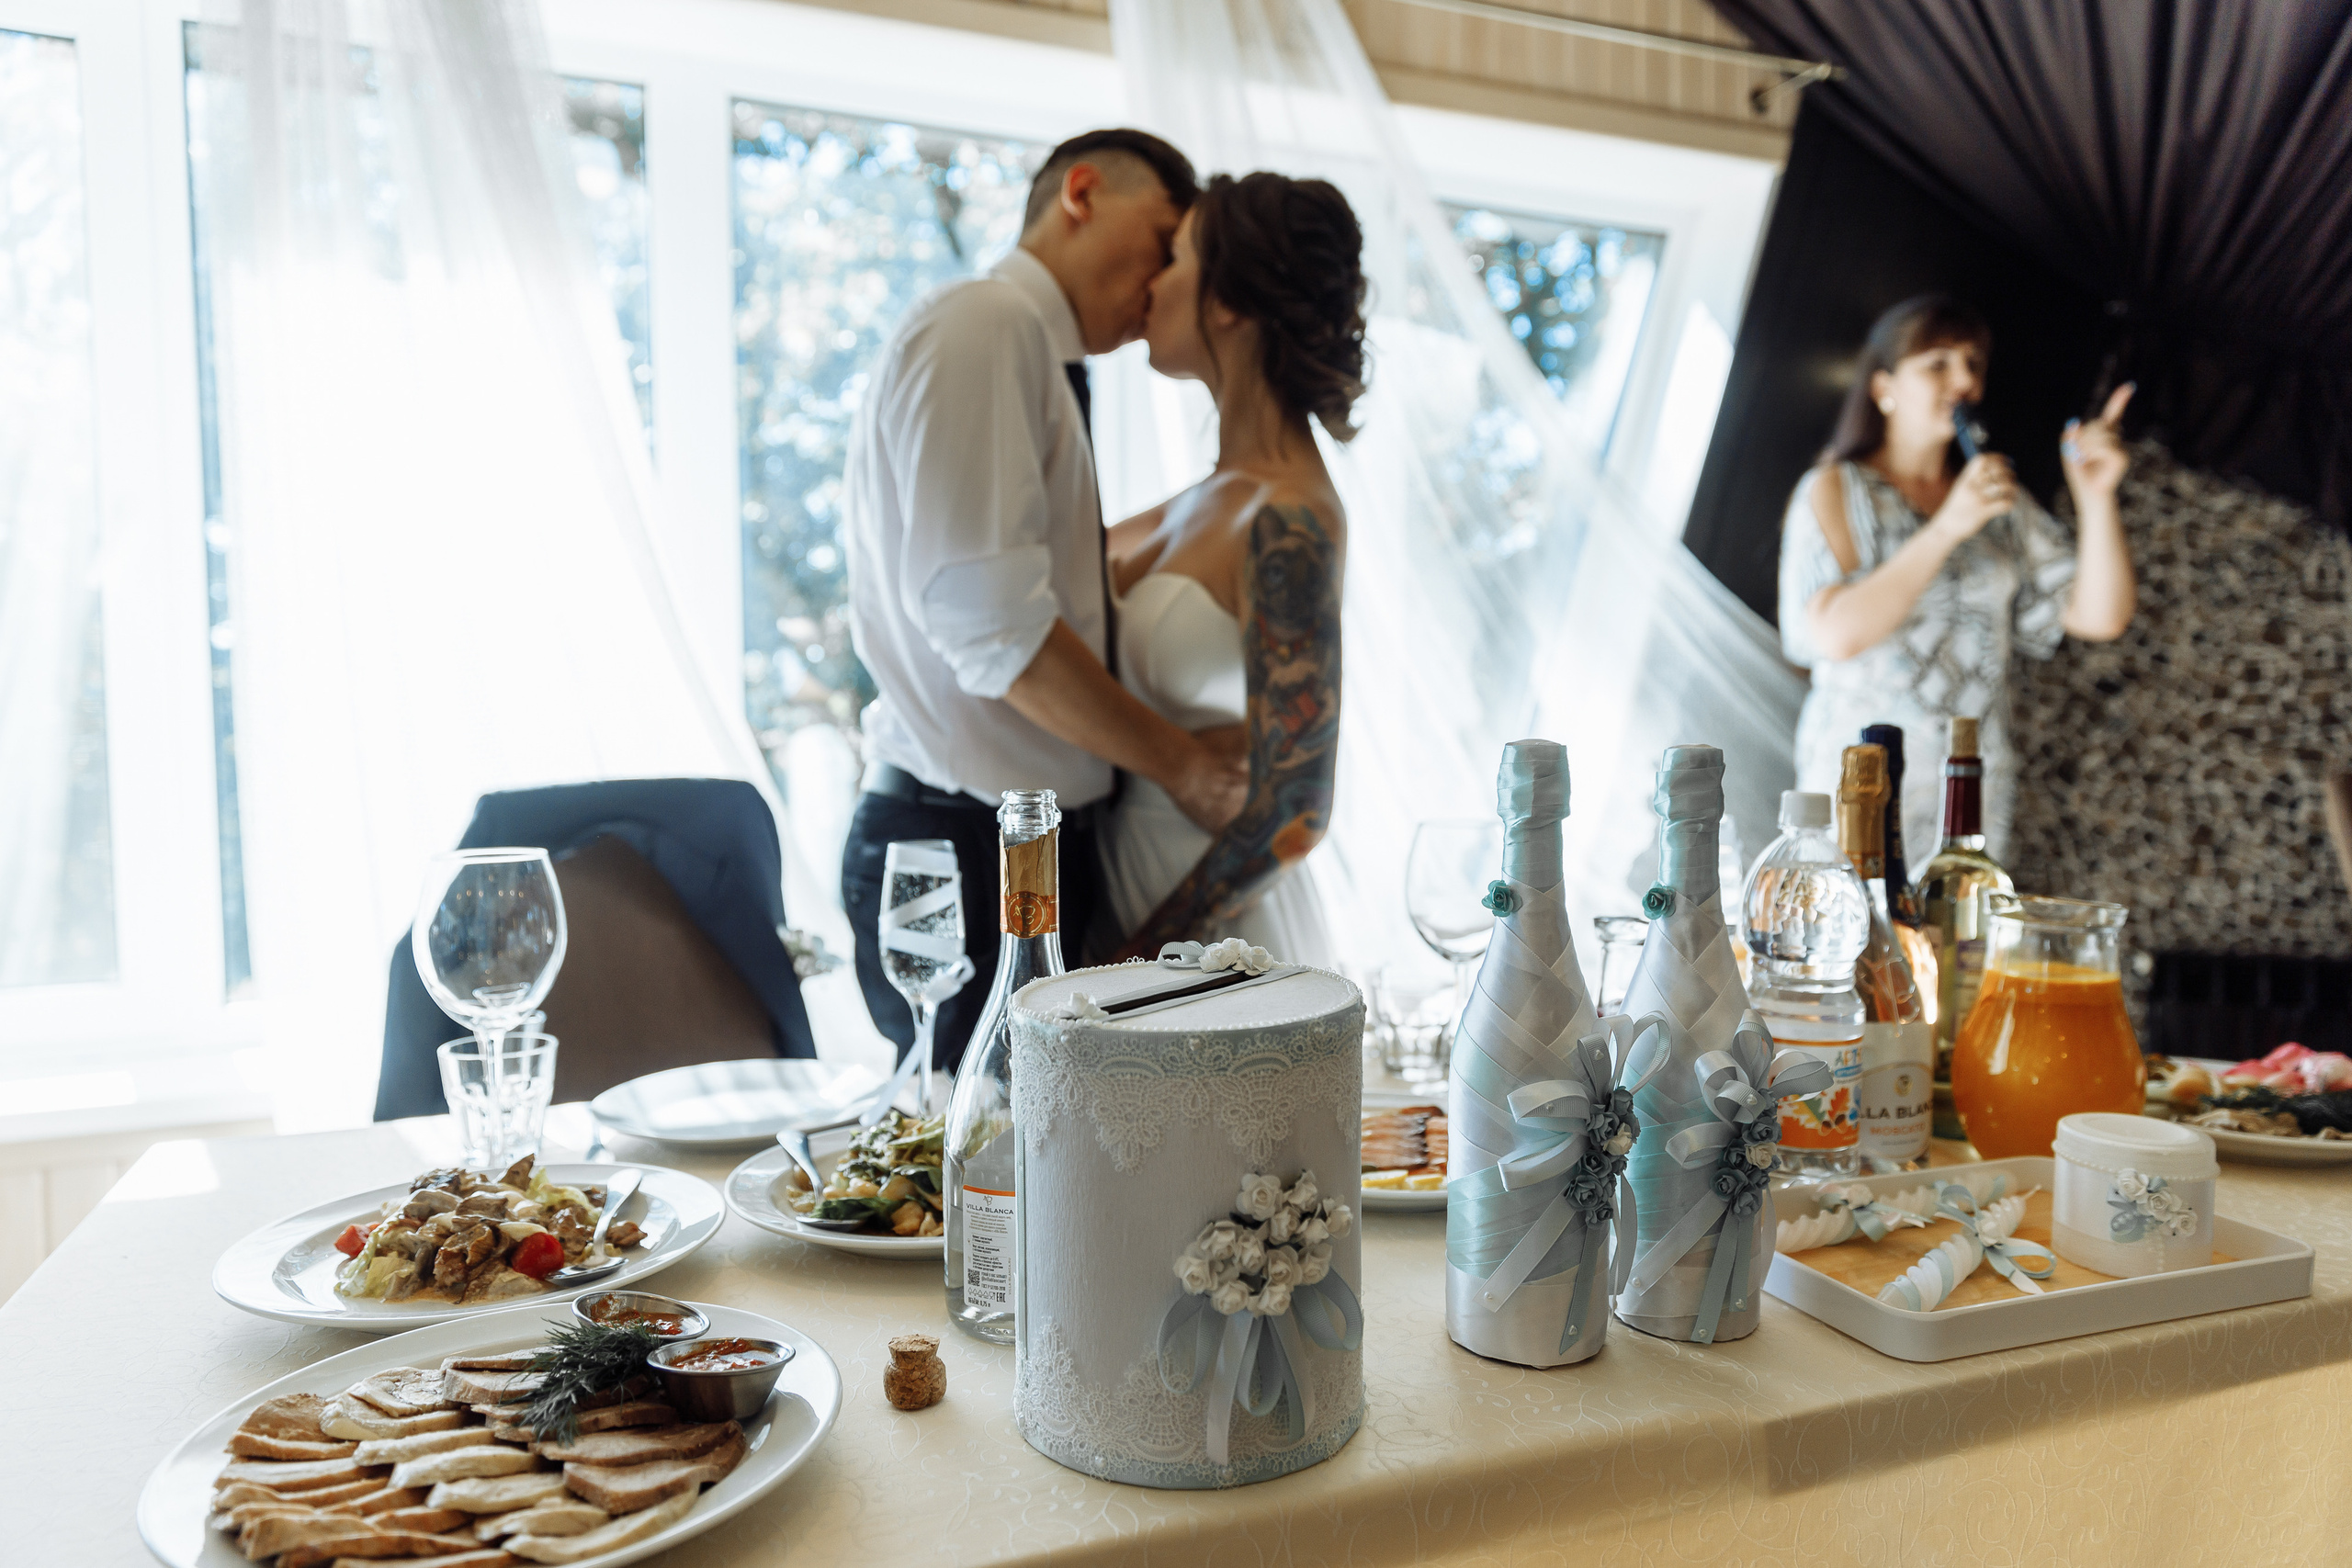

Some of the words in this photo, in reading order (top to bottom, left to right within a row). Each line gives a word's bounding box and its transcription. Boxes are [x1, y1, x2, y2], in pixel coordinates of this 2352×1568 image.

[966, 1202, 984, 1213] VILLA
[985, 1206, 1014, 1215] BLANCA
[996, 1292, 1006, 1303] EAC
